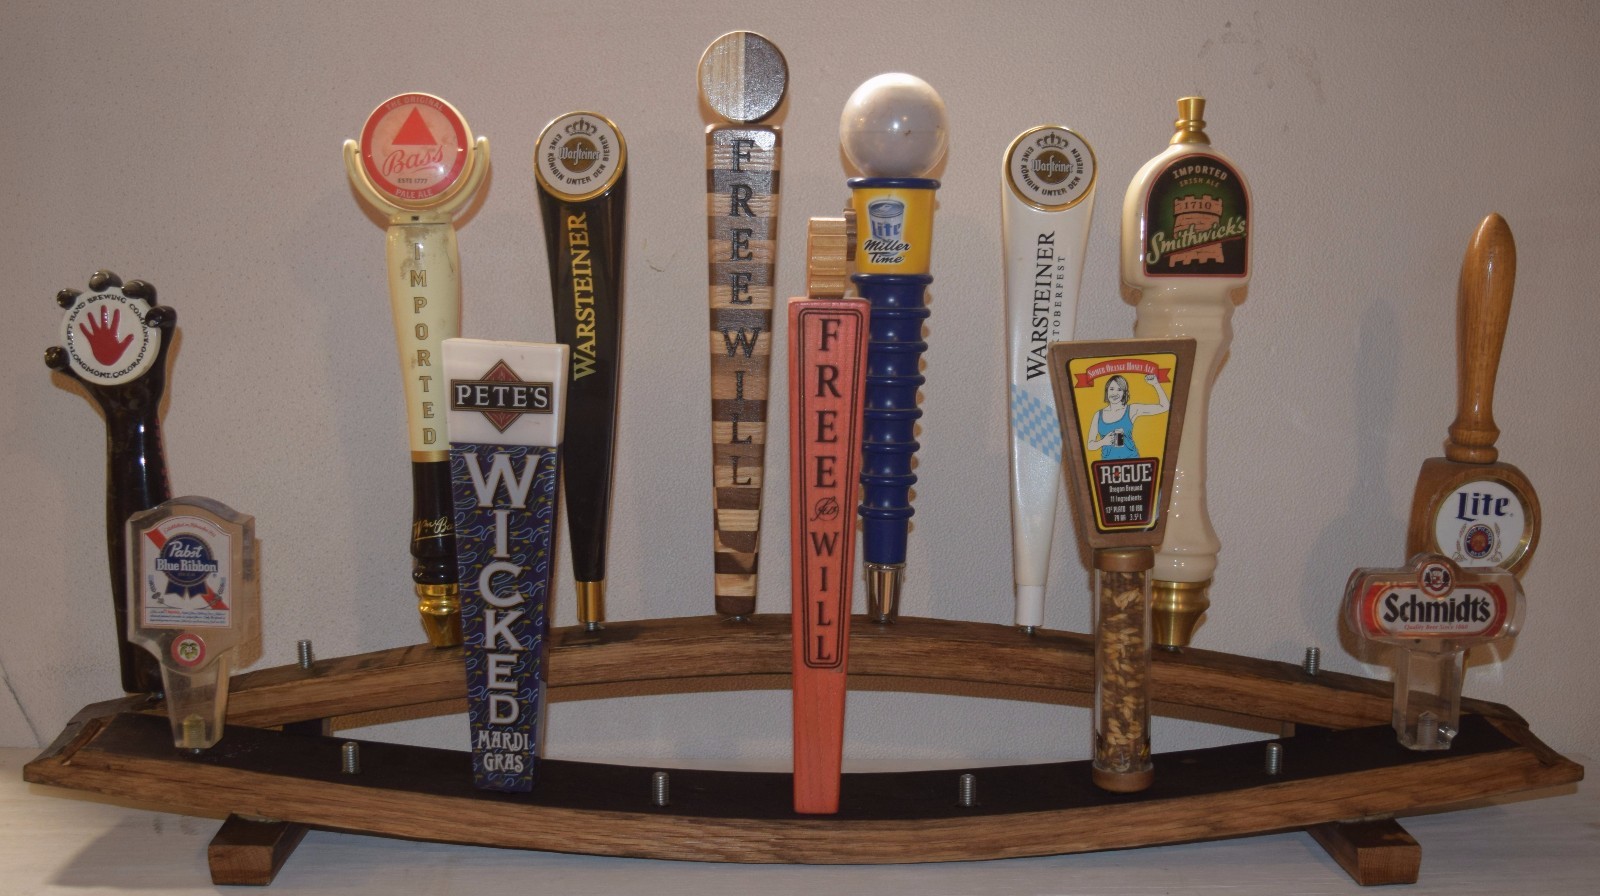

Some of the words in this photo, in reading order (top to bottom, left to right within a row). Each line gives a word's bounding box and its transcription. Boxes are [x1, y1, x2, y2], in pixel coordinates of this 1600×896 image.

[385, 98, 402, 111] THE
[403, 96, 444, 112] ORIGINAL
[549, 133, 563, 151] EINE
[598, 134, 611, 162] BIEREN
[382, 145, 444, 177] Bass
[1021, 146, 1035, 163] EINE
[1071, 148, 1084, 175] BIEREN
[566, 176, 592, 185] UNTER
[593, 163, 607, 178] DEN
[1172, 165, 1228, 180] IMPORTED
[395, 188, 416, 199] PALE
[418, 189, 433, 199] ALE
[1041, 188, 1067, 197] UNTER
[1068, 176, 1081, 190] DEN
[1180, 178, 1203, 187] IRISH
[1184, 201, 1212, 210] 1710
[728, 139, 757, 305] FREE
[863, 239, 911, 251] Miller
[1145, 215, 1246, 265] Smithwick's
[868, 252, 905, 264] Time
[567, 211, 596, 381] WARSTEINER
[1026, 231, 1055, 381] WARSTEINER
[1051, 255, 1066, 342] TOBERFEST
[66, 323, 74, 346] LEFT
[70, 302, 86, 322] HAND
[87, 294, 127, 304] BREWING
[128, 303, 150, 343] COMPANY
[409, 242, 437, 445] IMPORTED
[112, 345, 148, 378] COLORADO
[455, 385, 548, 408] PETE'S
[720, 327, 762, 486] WILL
[814, 318, 842, 488] FREE
[1100, 463, 1152, 485] ROGUE
[1456, 492, 1510, 522] Lite
[168, 540, 203, 558] Pabst
[156, 559, 180, 571] Blue
[180, 559, 217, 572] Ribbon
[461, 452, 542, 725] WICKED
[810, 531, 839, 661] WILL
[1383, 592, 1491, 623] Schmidt's
[477, 730, 529, 752] MARDI
[483, 752, 524, 773] GRAS
